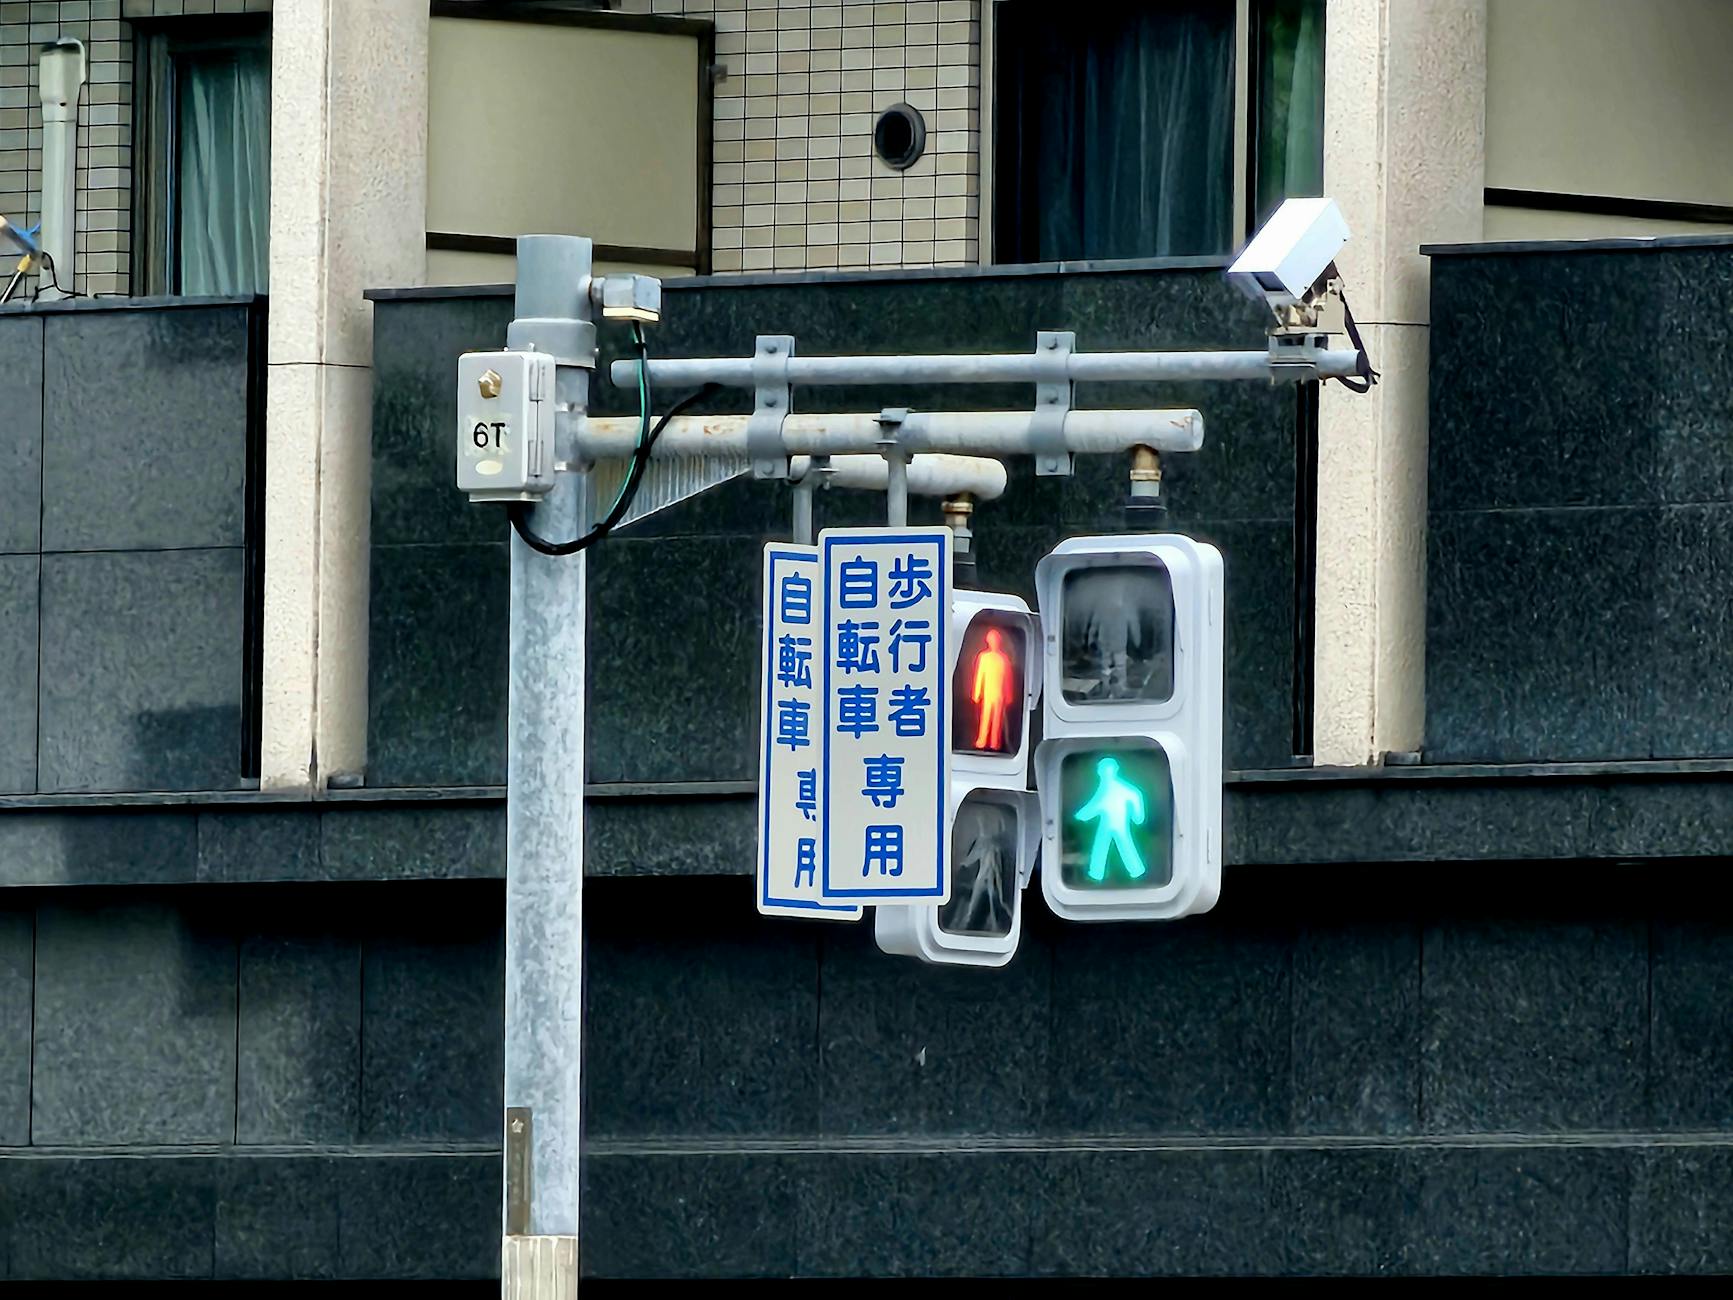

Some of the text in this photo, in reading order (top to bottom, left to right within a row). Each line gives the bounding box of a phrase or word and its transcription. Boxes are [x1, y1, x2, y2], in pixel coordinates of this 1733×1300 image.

[473, 422, 506, 448] 6T
[776, 571, 812, 752] 自転車
[836, 555, 880, 739] 自転車
[888, 553, 932, 737] 歩行者
[861, 753, 905, 877] 専用
